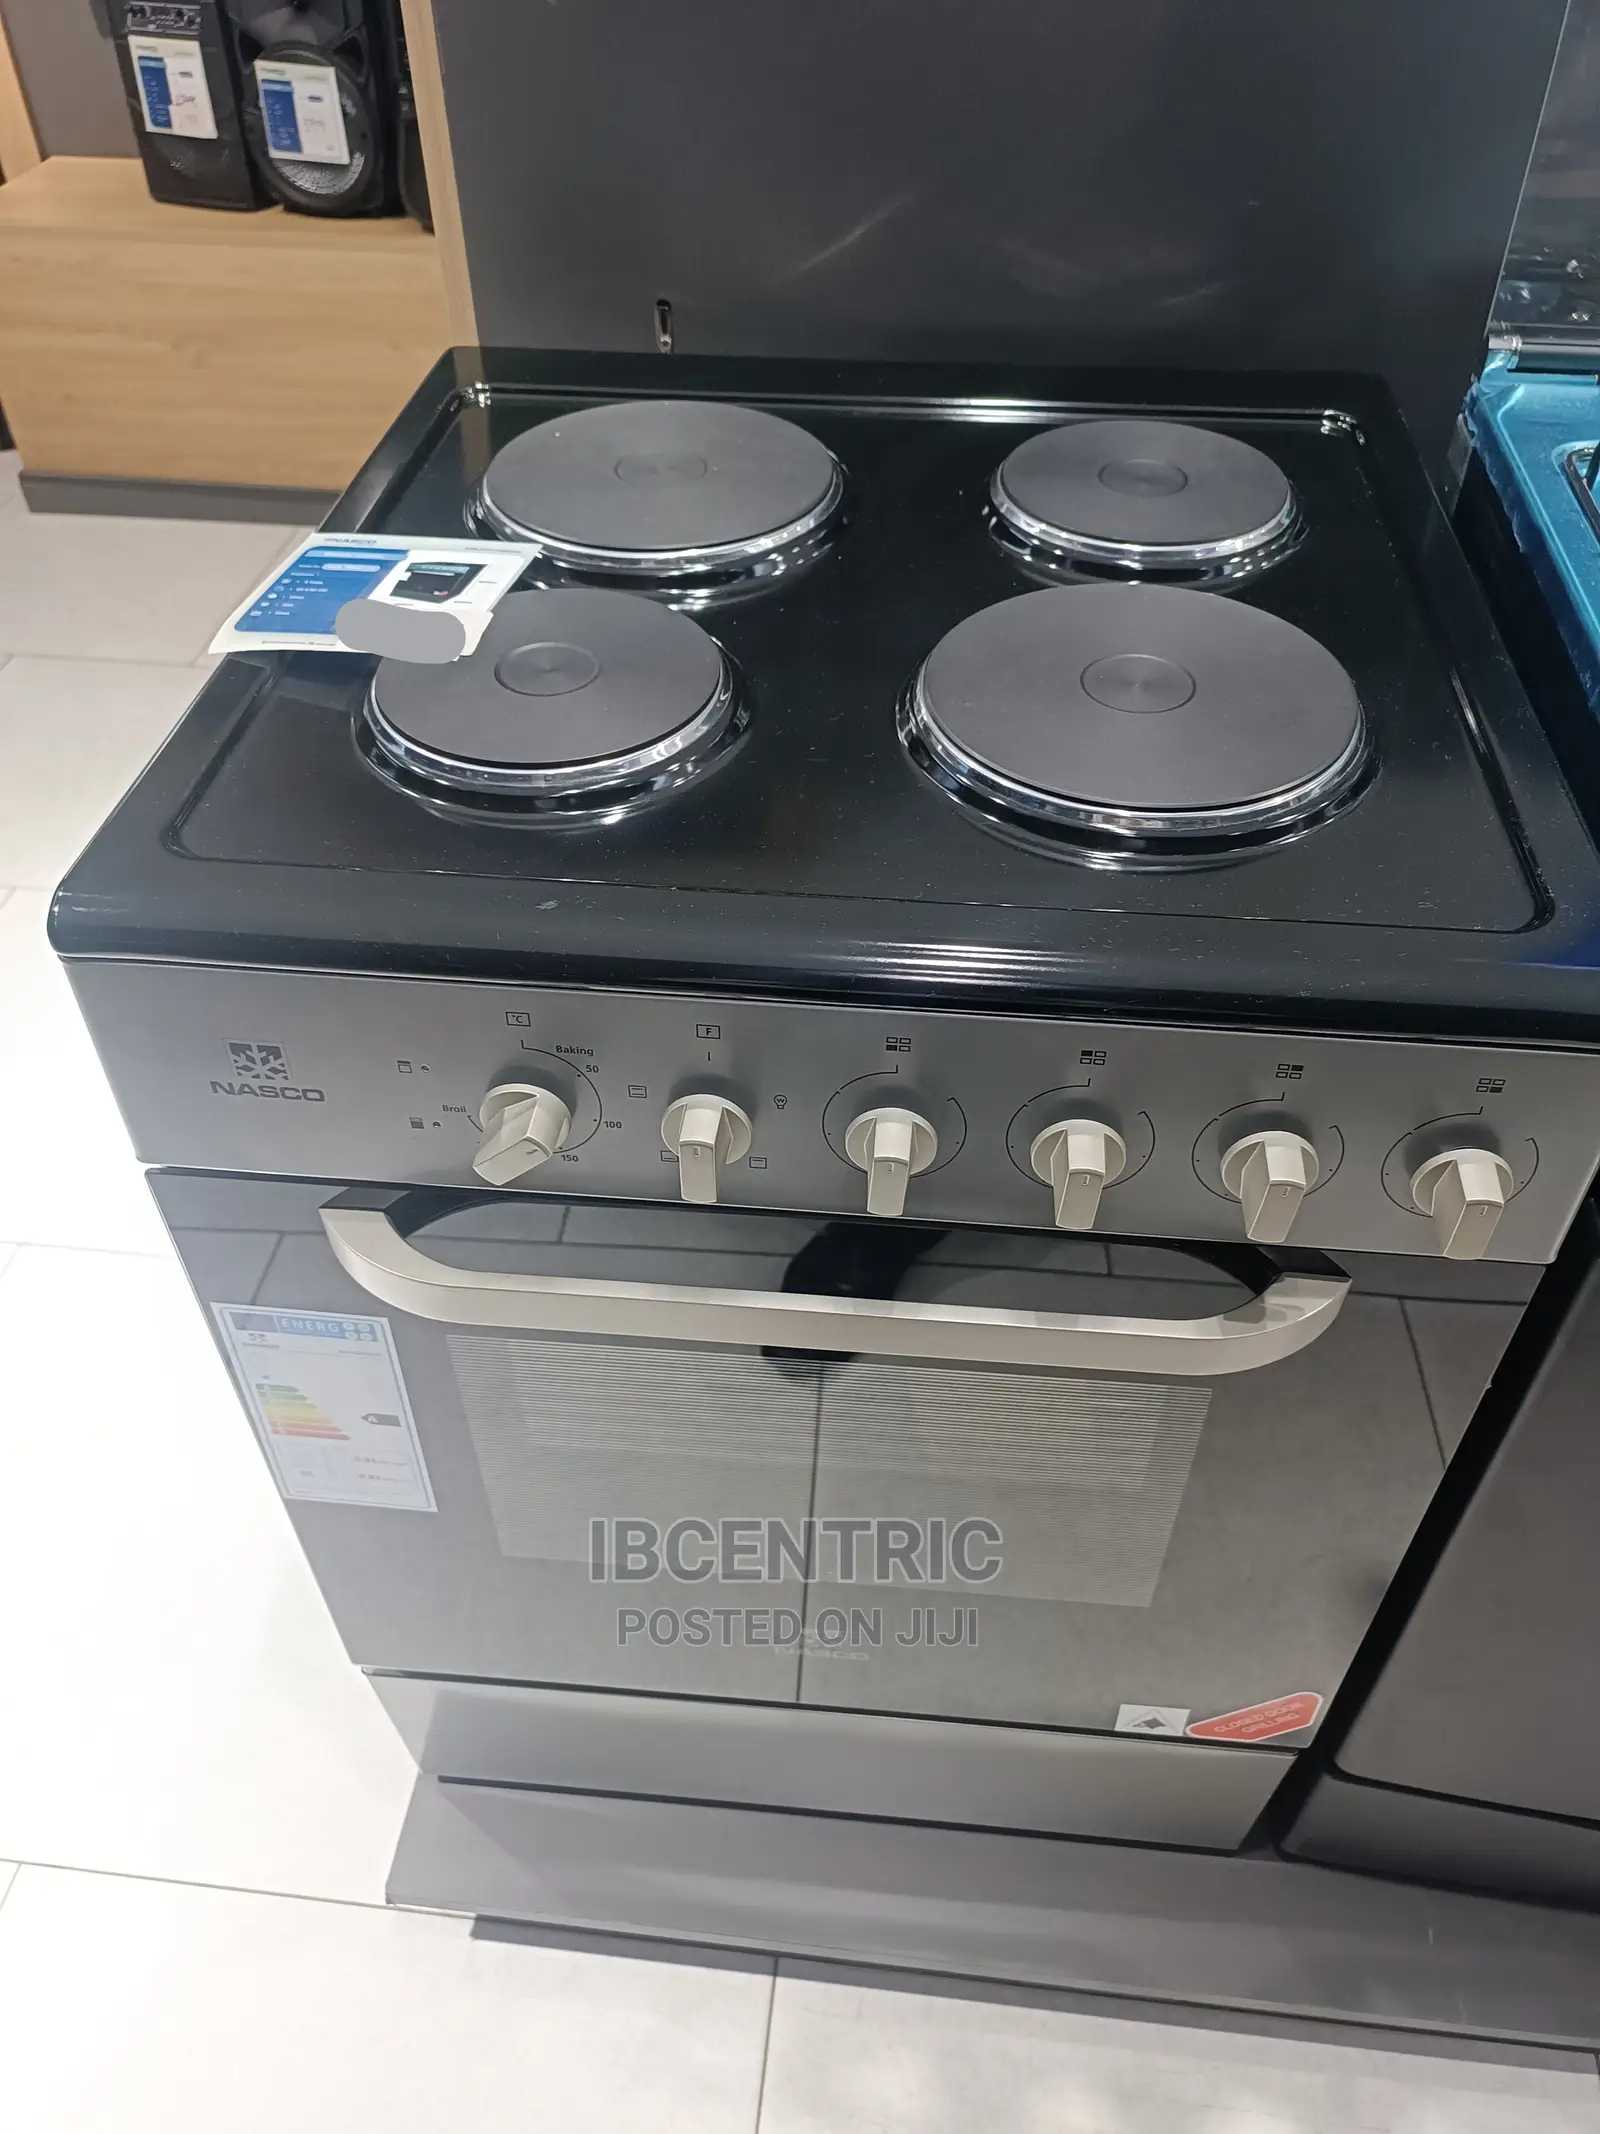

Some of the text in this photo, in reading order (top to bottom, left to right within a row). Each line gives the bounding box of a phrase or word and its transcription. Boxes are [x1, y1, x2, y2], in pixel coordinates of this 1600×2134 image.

[555, 1044, 595, 1057] Baking
[585, 1064, 600, 1074] 50
[209, 1080, 325, 1102] NASCO
[442, 1103, 467, 1114] Broil
[603, 1119, 622, 1130] 100
[560, 1153, 579, 1163] 150
[281, 1317, 341, 1333] ENERG
[1213, 1714, 1264, 1732] CLOSED
